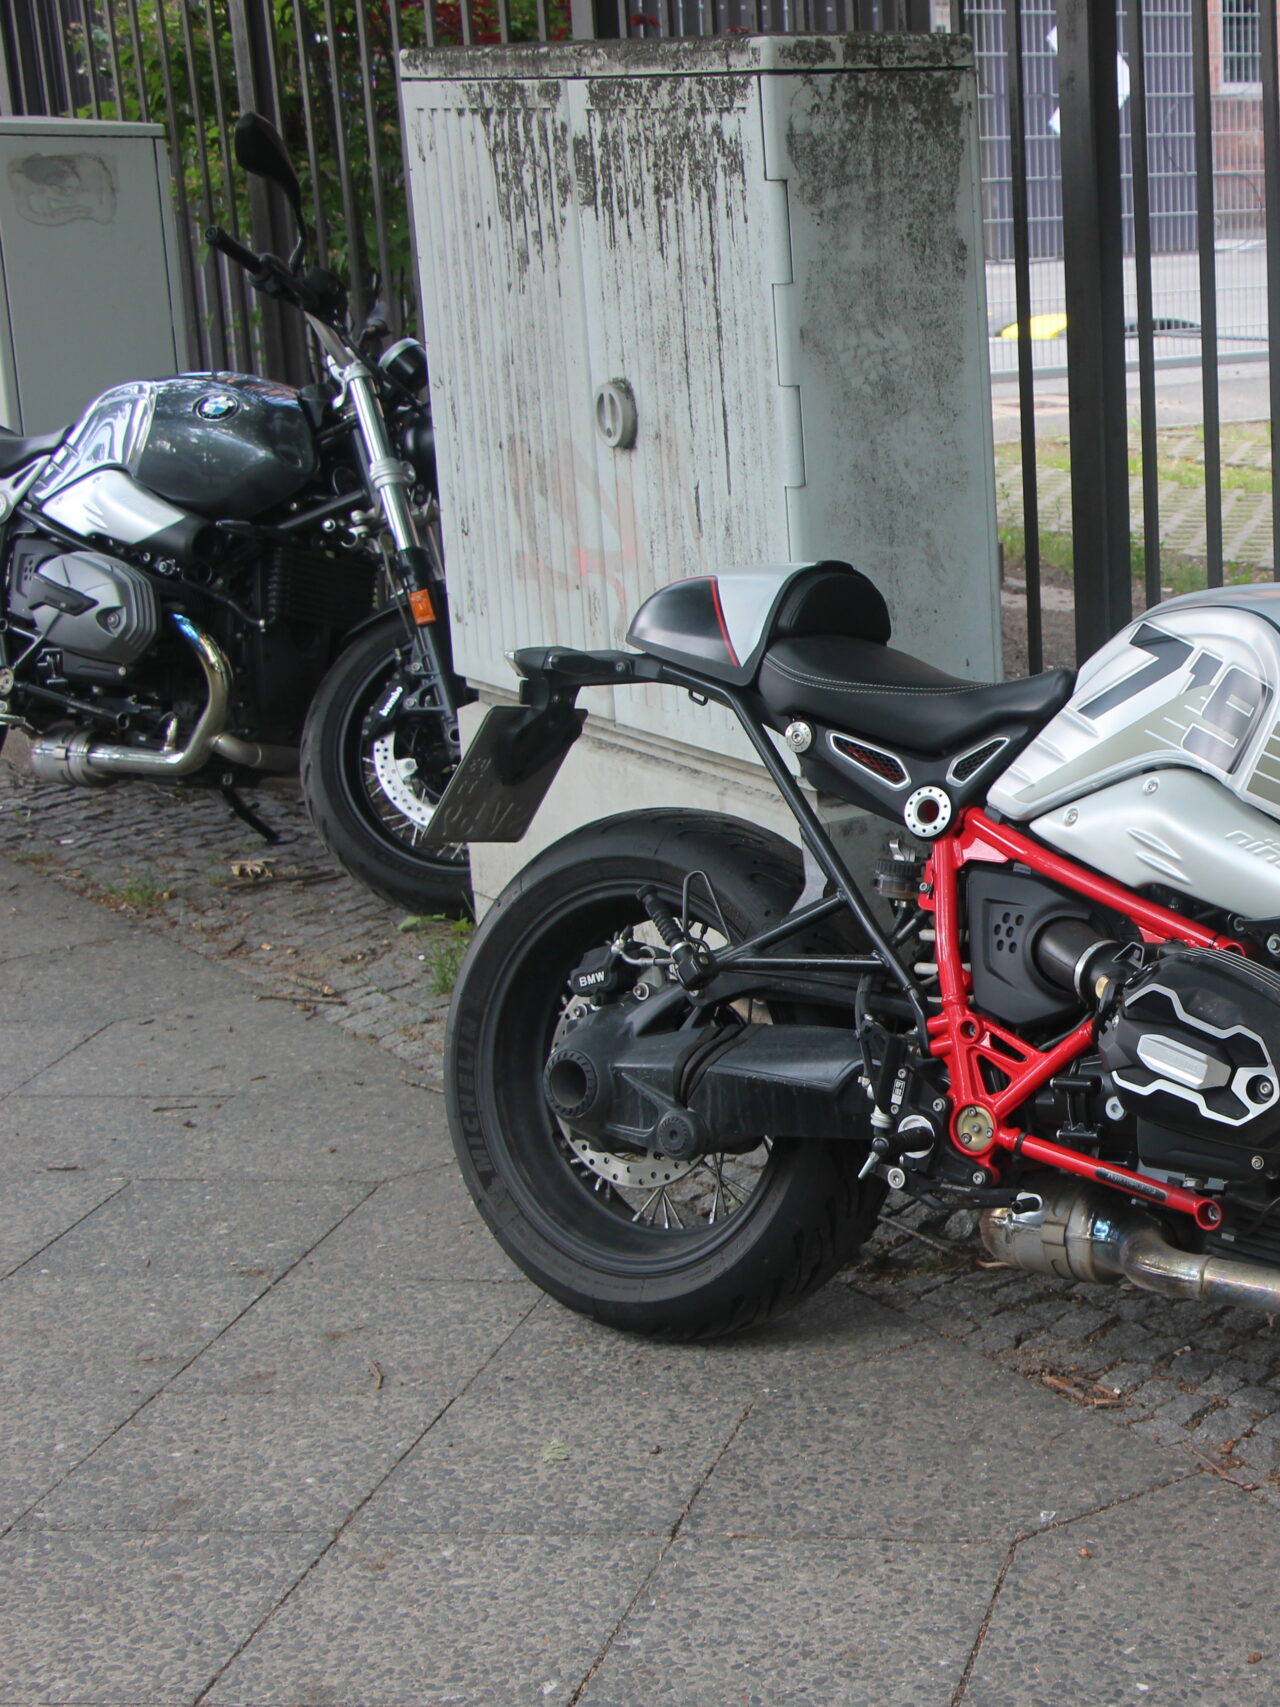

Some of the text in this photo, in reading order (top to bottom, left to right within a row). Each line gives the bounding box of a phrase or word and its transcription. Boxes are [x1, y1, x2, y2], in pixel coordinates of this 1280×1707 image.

[378, 686, 403, 717] brembo
[579, 970, 605, 988] BMW
[457, 1015, 494, 1173] MICHELIN
